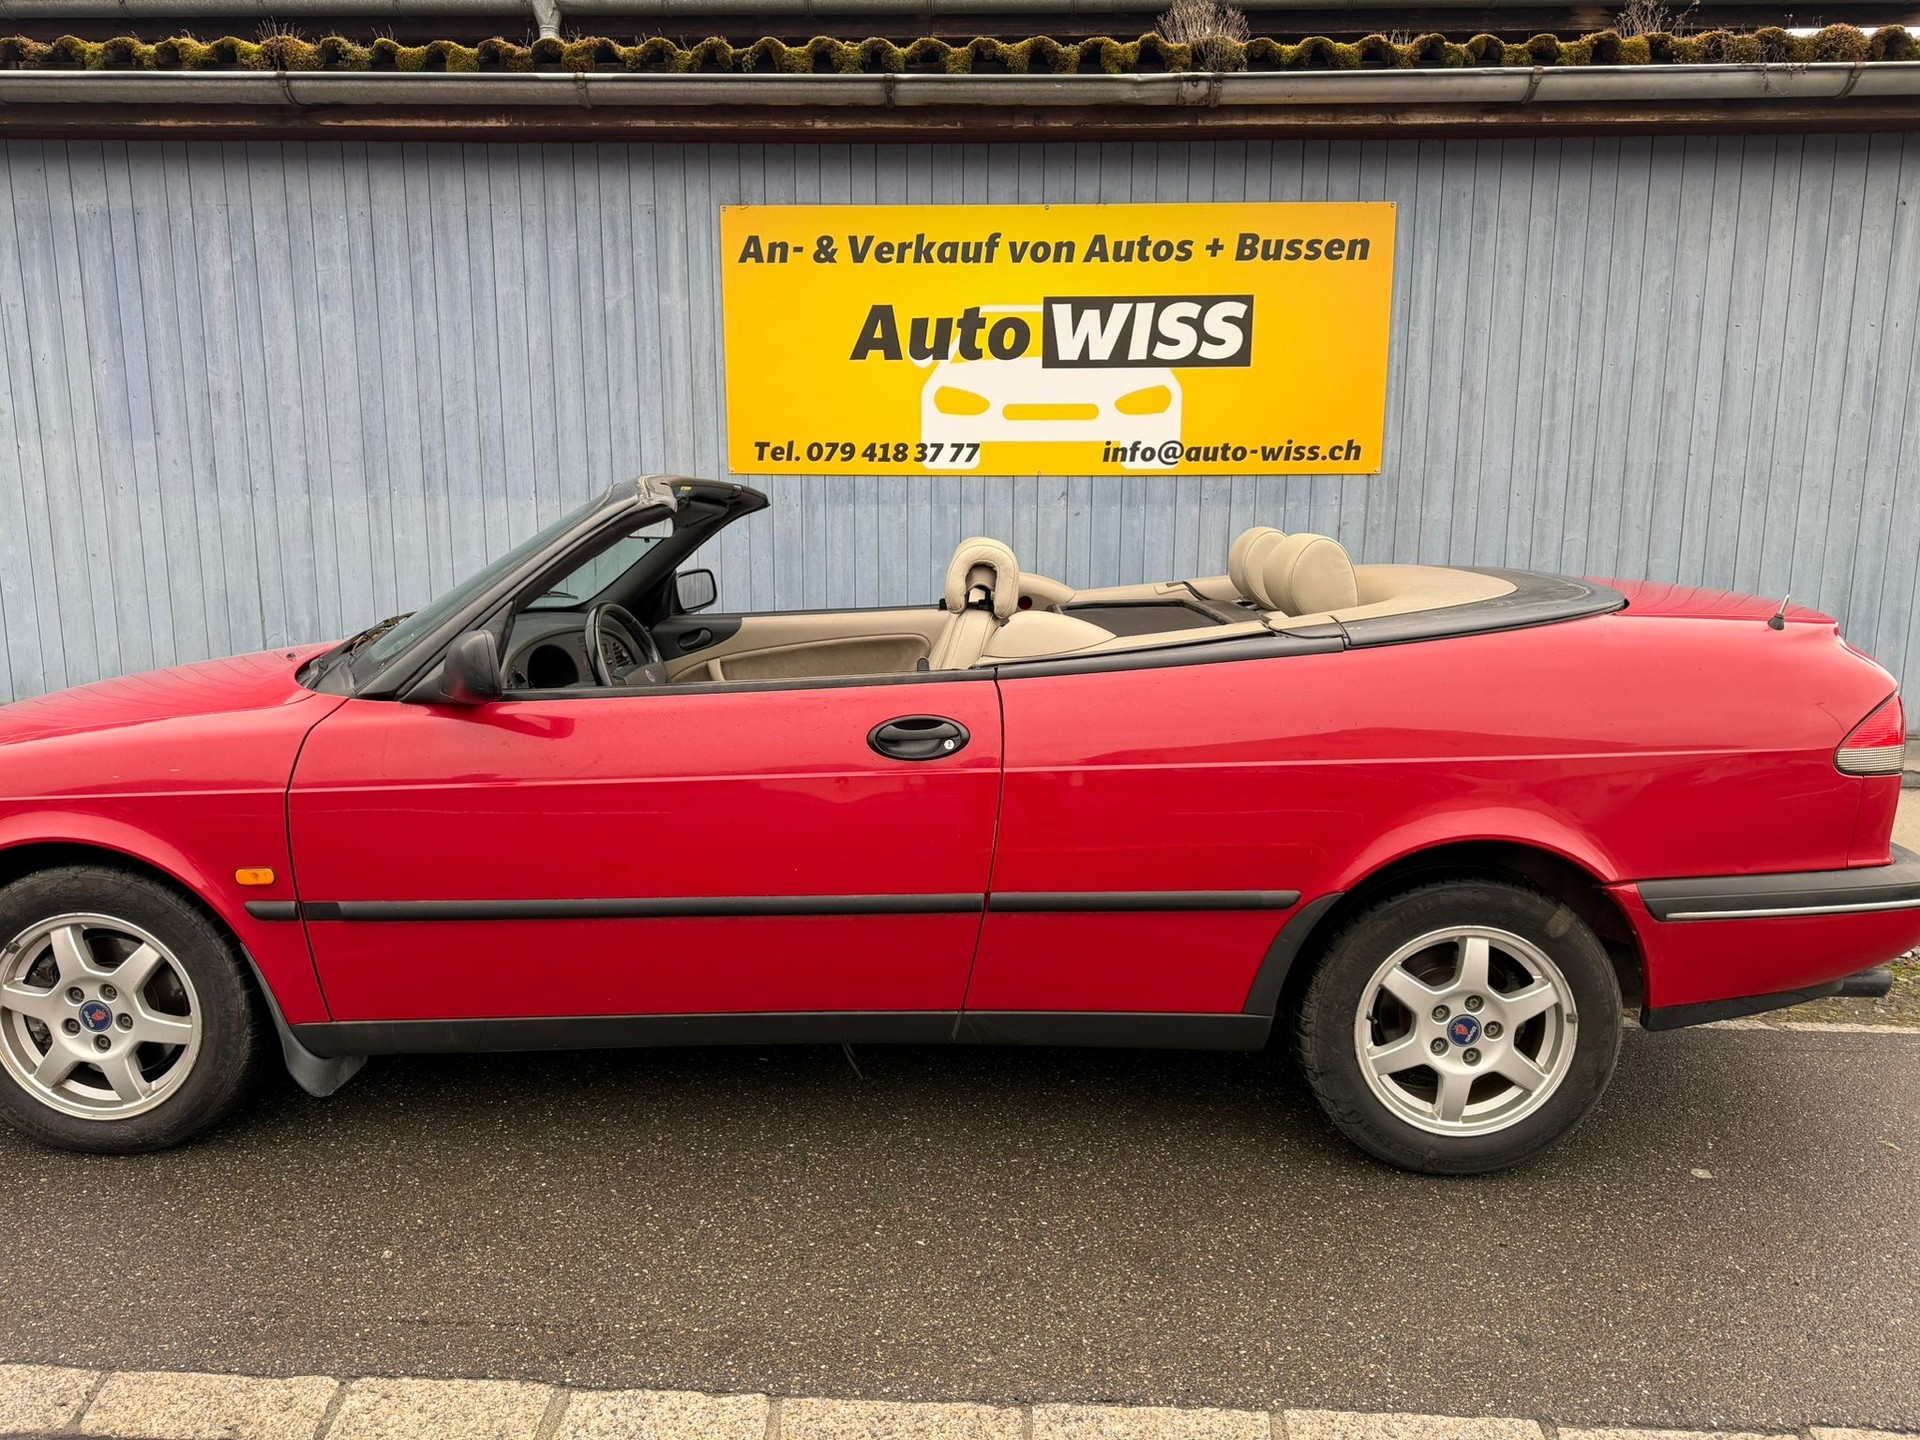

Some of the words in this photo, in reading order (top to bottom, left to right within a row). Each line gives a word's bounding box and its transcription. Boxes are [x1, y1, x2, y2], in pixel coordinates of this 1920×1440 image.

[738, 235, 804, 264] An-
[813, 235, 838, 263] &
[848, 232, 1002, 264] Verkauf
[1008, 240, 1076, 263] von
[1082, 234, 1194, 263] Autos
[1205, 238, 1224, 257] +
[1235, 233, 1370, 261] Bussen
[849, 304, 1031, 361] Auto
[1050, 301, 1248, 361] WISS
[754, 440, 800, 462] Tel.
[806, 442, 856, 462] 079
[861, 442, 909, 463] 418
[912, 442, 945, 463] 37
[948, 442, 981, 463] 77
[1102, 439, 1362, 466] info@auto-wiss.ch
